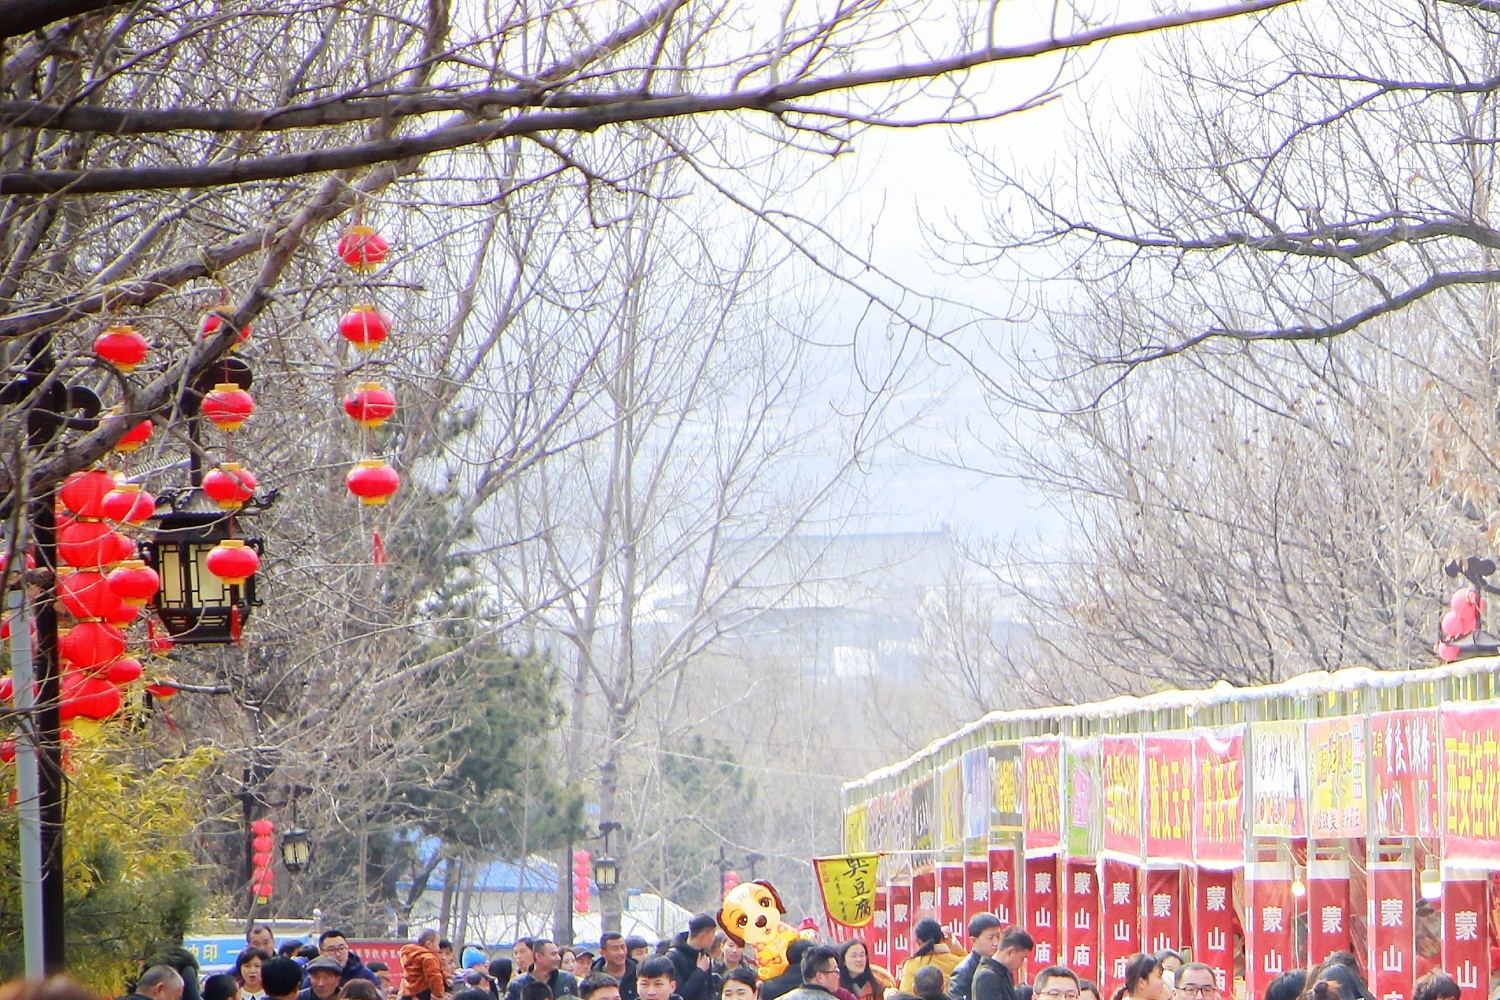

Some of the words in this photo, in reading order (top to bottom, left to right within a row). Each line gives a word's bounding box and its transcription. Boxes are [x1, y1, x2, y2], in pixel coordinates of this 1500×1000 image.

[992, 870, 1009, 925] 蒙山
[1034, 872, 1052, 964] 蒙山庙
[1073, 872, 1092, 968] 蒙山庙
[1262, 906, 1284, 975] 蒙山
